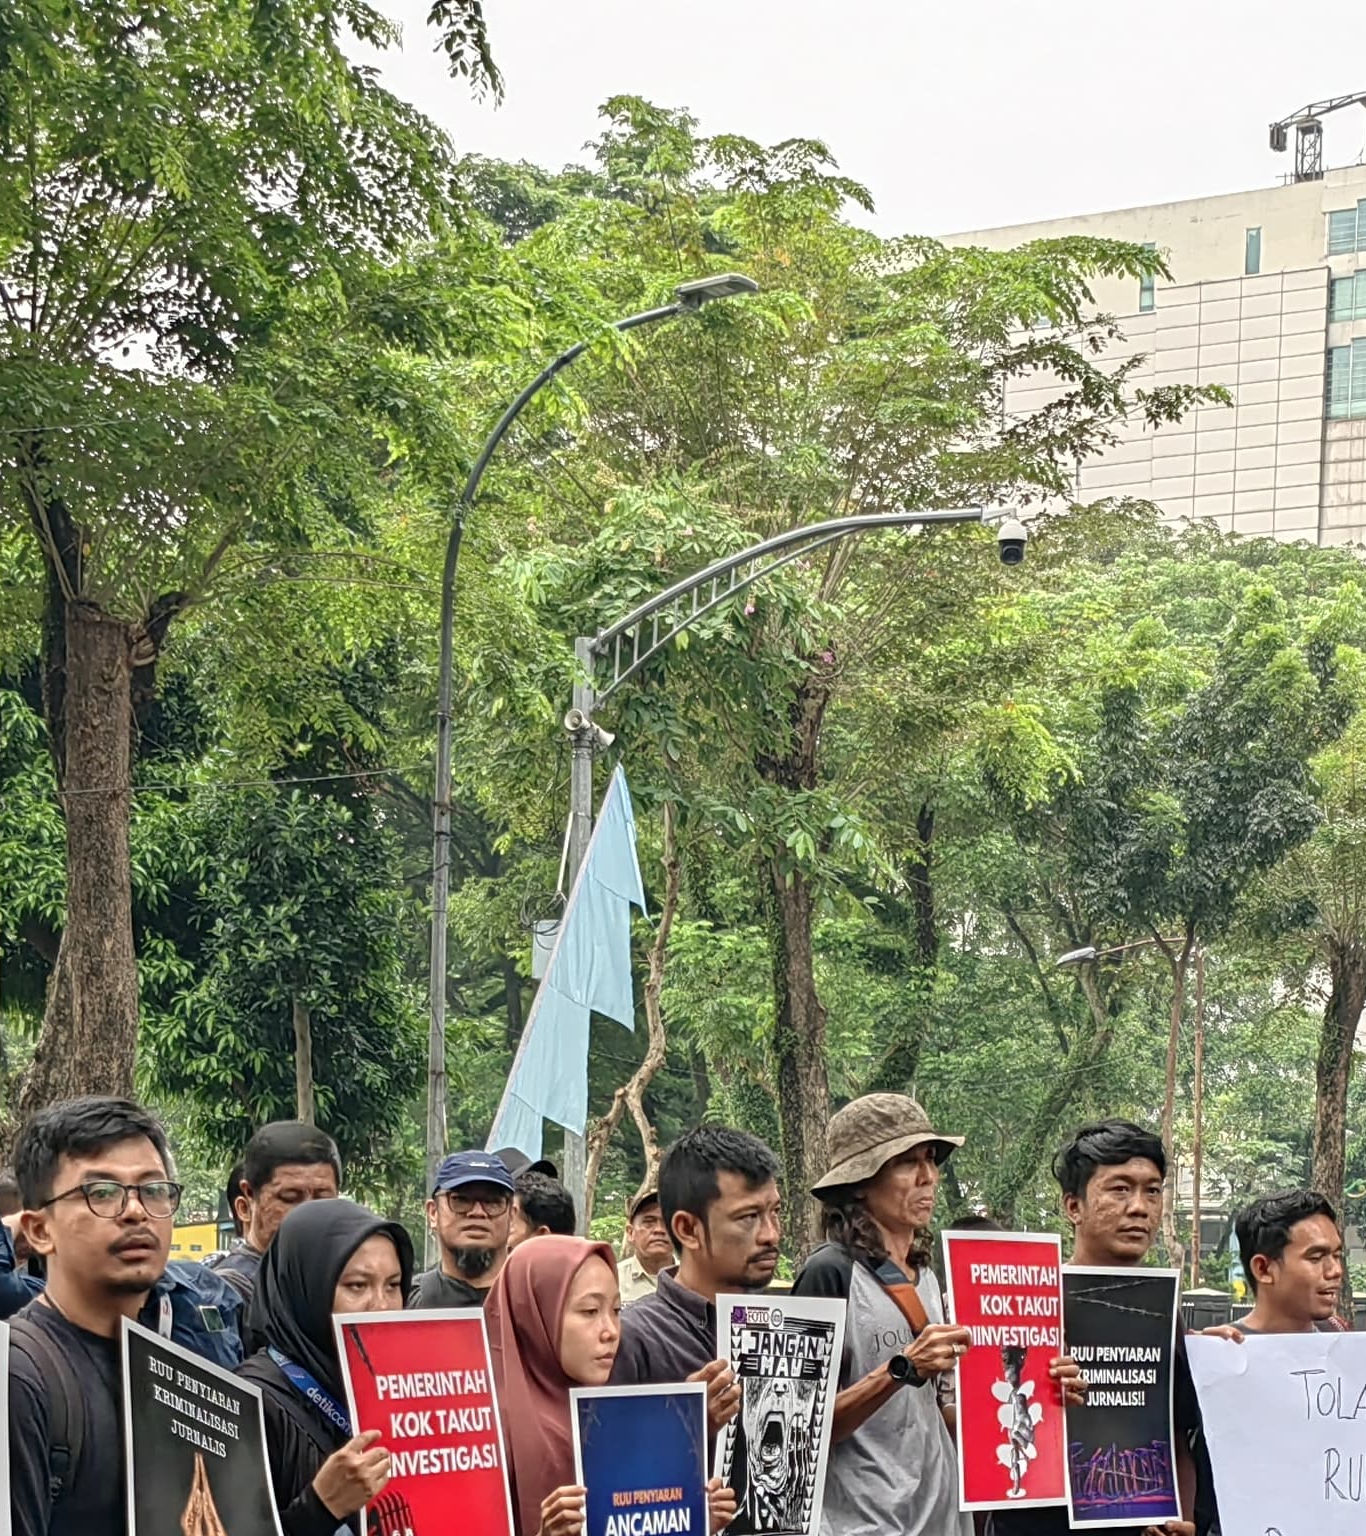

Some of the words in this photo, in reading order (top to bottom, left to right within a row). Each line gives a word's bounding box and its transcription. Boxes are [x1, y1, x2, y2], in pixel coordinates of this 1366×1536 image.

[970, 1264, 1057, 1286] PEMERINTAH
[748, 1311, 769, 1323] FOTO
[980, 1295, 1013, 1316] KOK
[1015, 1296, 1058, 1317] TAKUT
[748, 1332, 819, 1358] JANGAN
[874, 1328, 910, 1353] JOU
[1070, 1346, 1094, 1362] RUU
[1096, 1347, 1161, 1362] PENYIARAN
[760, 1356, 803, 1377] MAU
[148, 1355, 173, 1381] RUU
[176, 1370, 240, 1416] PENYIARAN
[375, 1369, 488, 1400] PEMERINTAH
[1087, 1391, 1145, 1406] JURNALIS!!
[153, 1384, 239, 1440] KRIMINALISASI
[390, 1410, 434, 1439] KOK
[435, 1407, 491, 1434] TAKUT
[171, 1419, 226, 1458] JURNALIS
[612, 1491, 632, 1507] RUU
[633, 1487, 683, 1504] PENYIARAN
